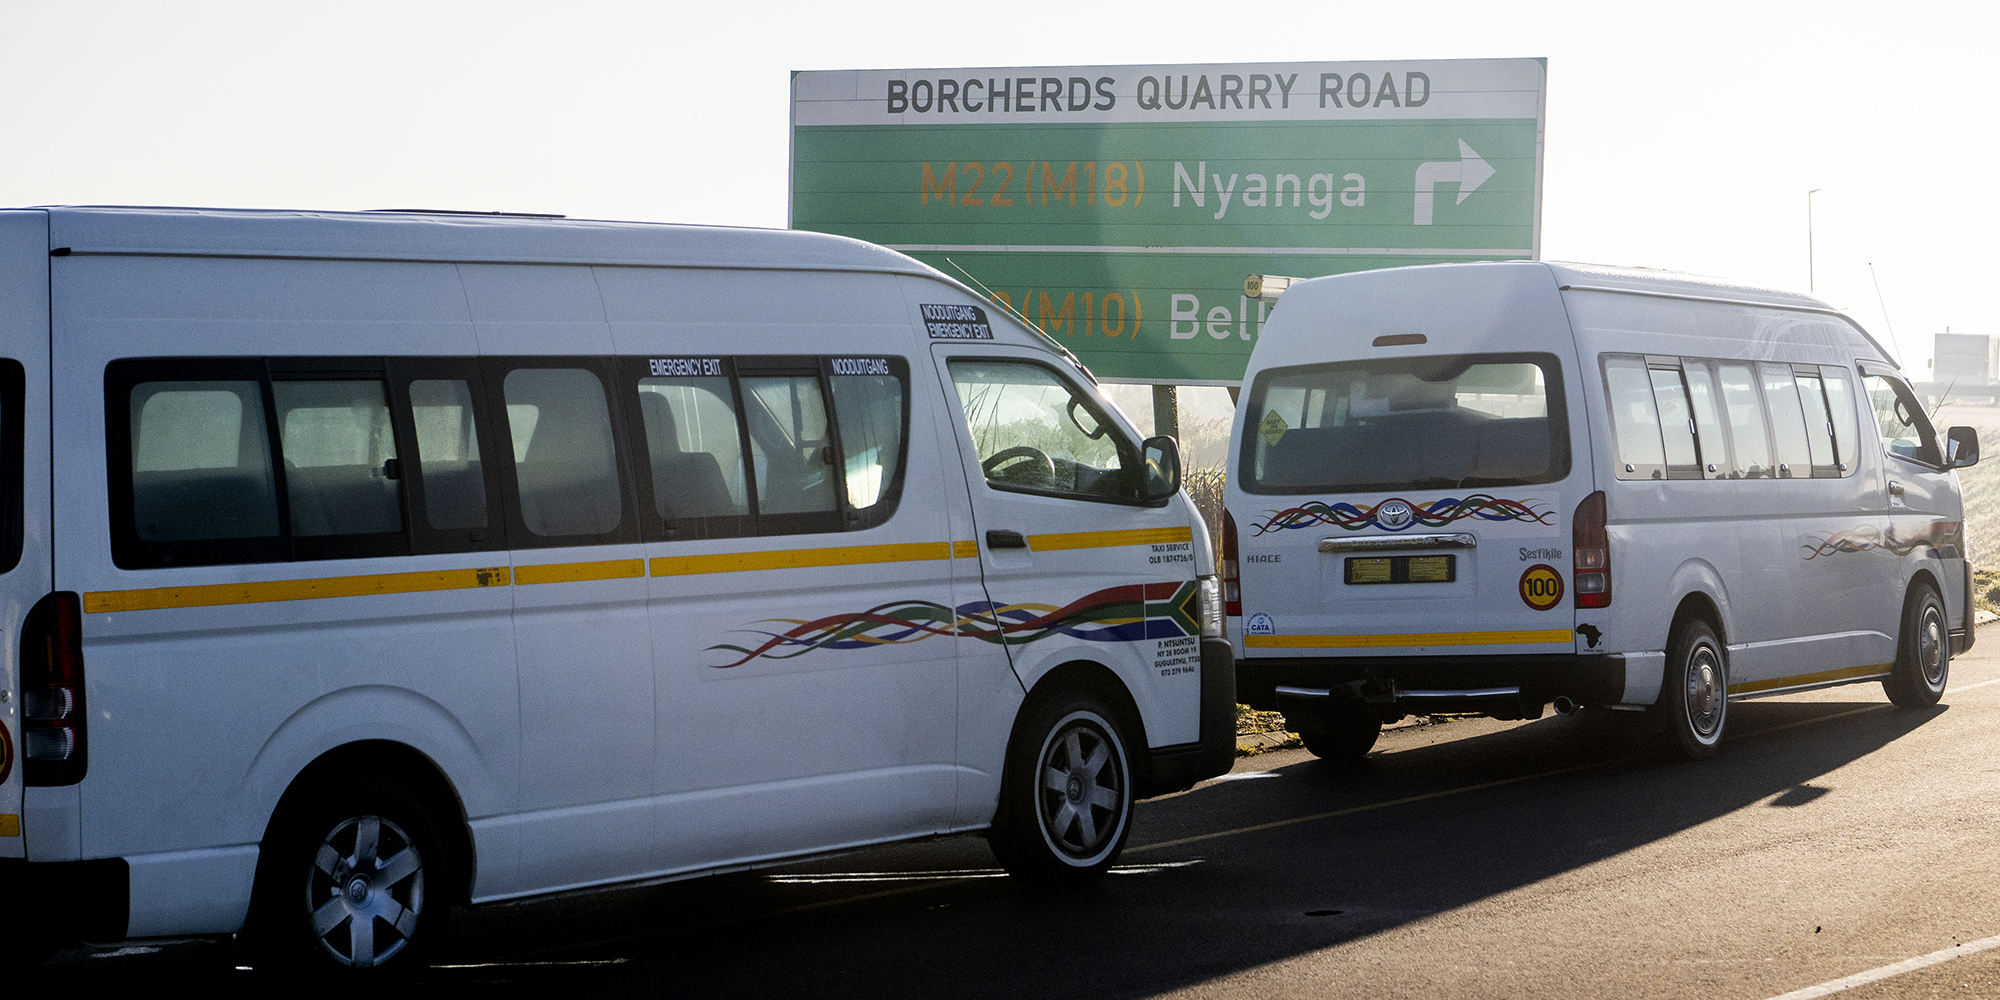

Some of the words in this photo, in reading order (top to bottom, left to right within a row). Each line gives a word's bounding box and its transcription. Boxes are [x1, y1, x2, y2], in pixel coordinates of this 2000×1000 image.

[887, 76, 1117, 114] BORCHERDS
[1136, 73, 1299, 111] QUARRY
[1319, 71, 1431, 109] ROAD
[1173, 161, 1366, 220] Nyanga
[1247, 281, 1259, 291] 100
[922, 304, 977, 321] NOODUITGANG
[927, 322, 974, 338] EMERGENCY
[972, 324, 990, 339] EXIT
[649, 358, 702, 376] EMERGENCY
[702, 358, 722, 376] EXIT
[831, 358, 889, 375] NOODUITGANG
[1151, 545, 1166, 553] TAXI
[1166, 543, 1189, 552] SERVICE
[1149, 556, 1161, 564] OLB
[1247, 554, 1282, 563] HIACE
[1526, 578, 1557, 597] 100
[1163, 637, 1196, 648] NTSUNTSU
[1157, 650, 1165, 658] NY
[1173, 648, 1190, 656] ROOM
[1161, 669, 1171, 677] 073
